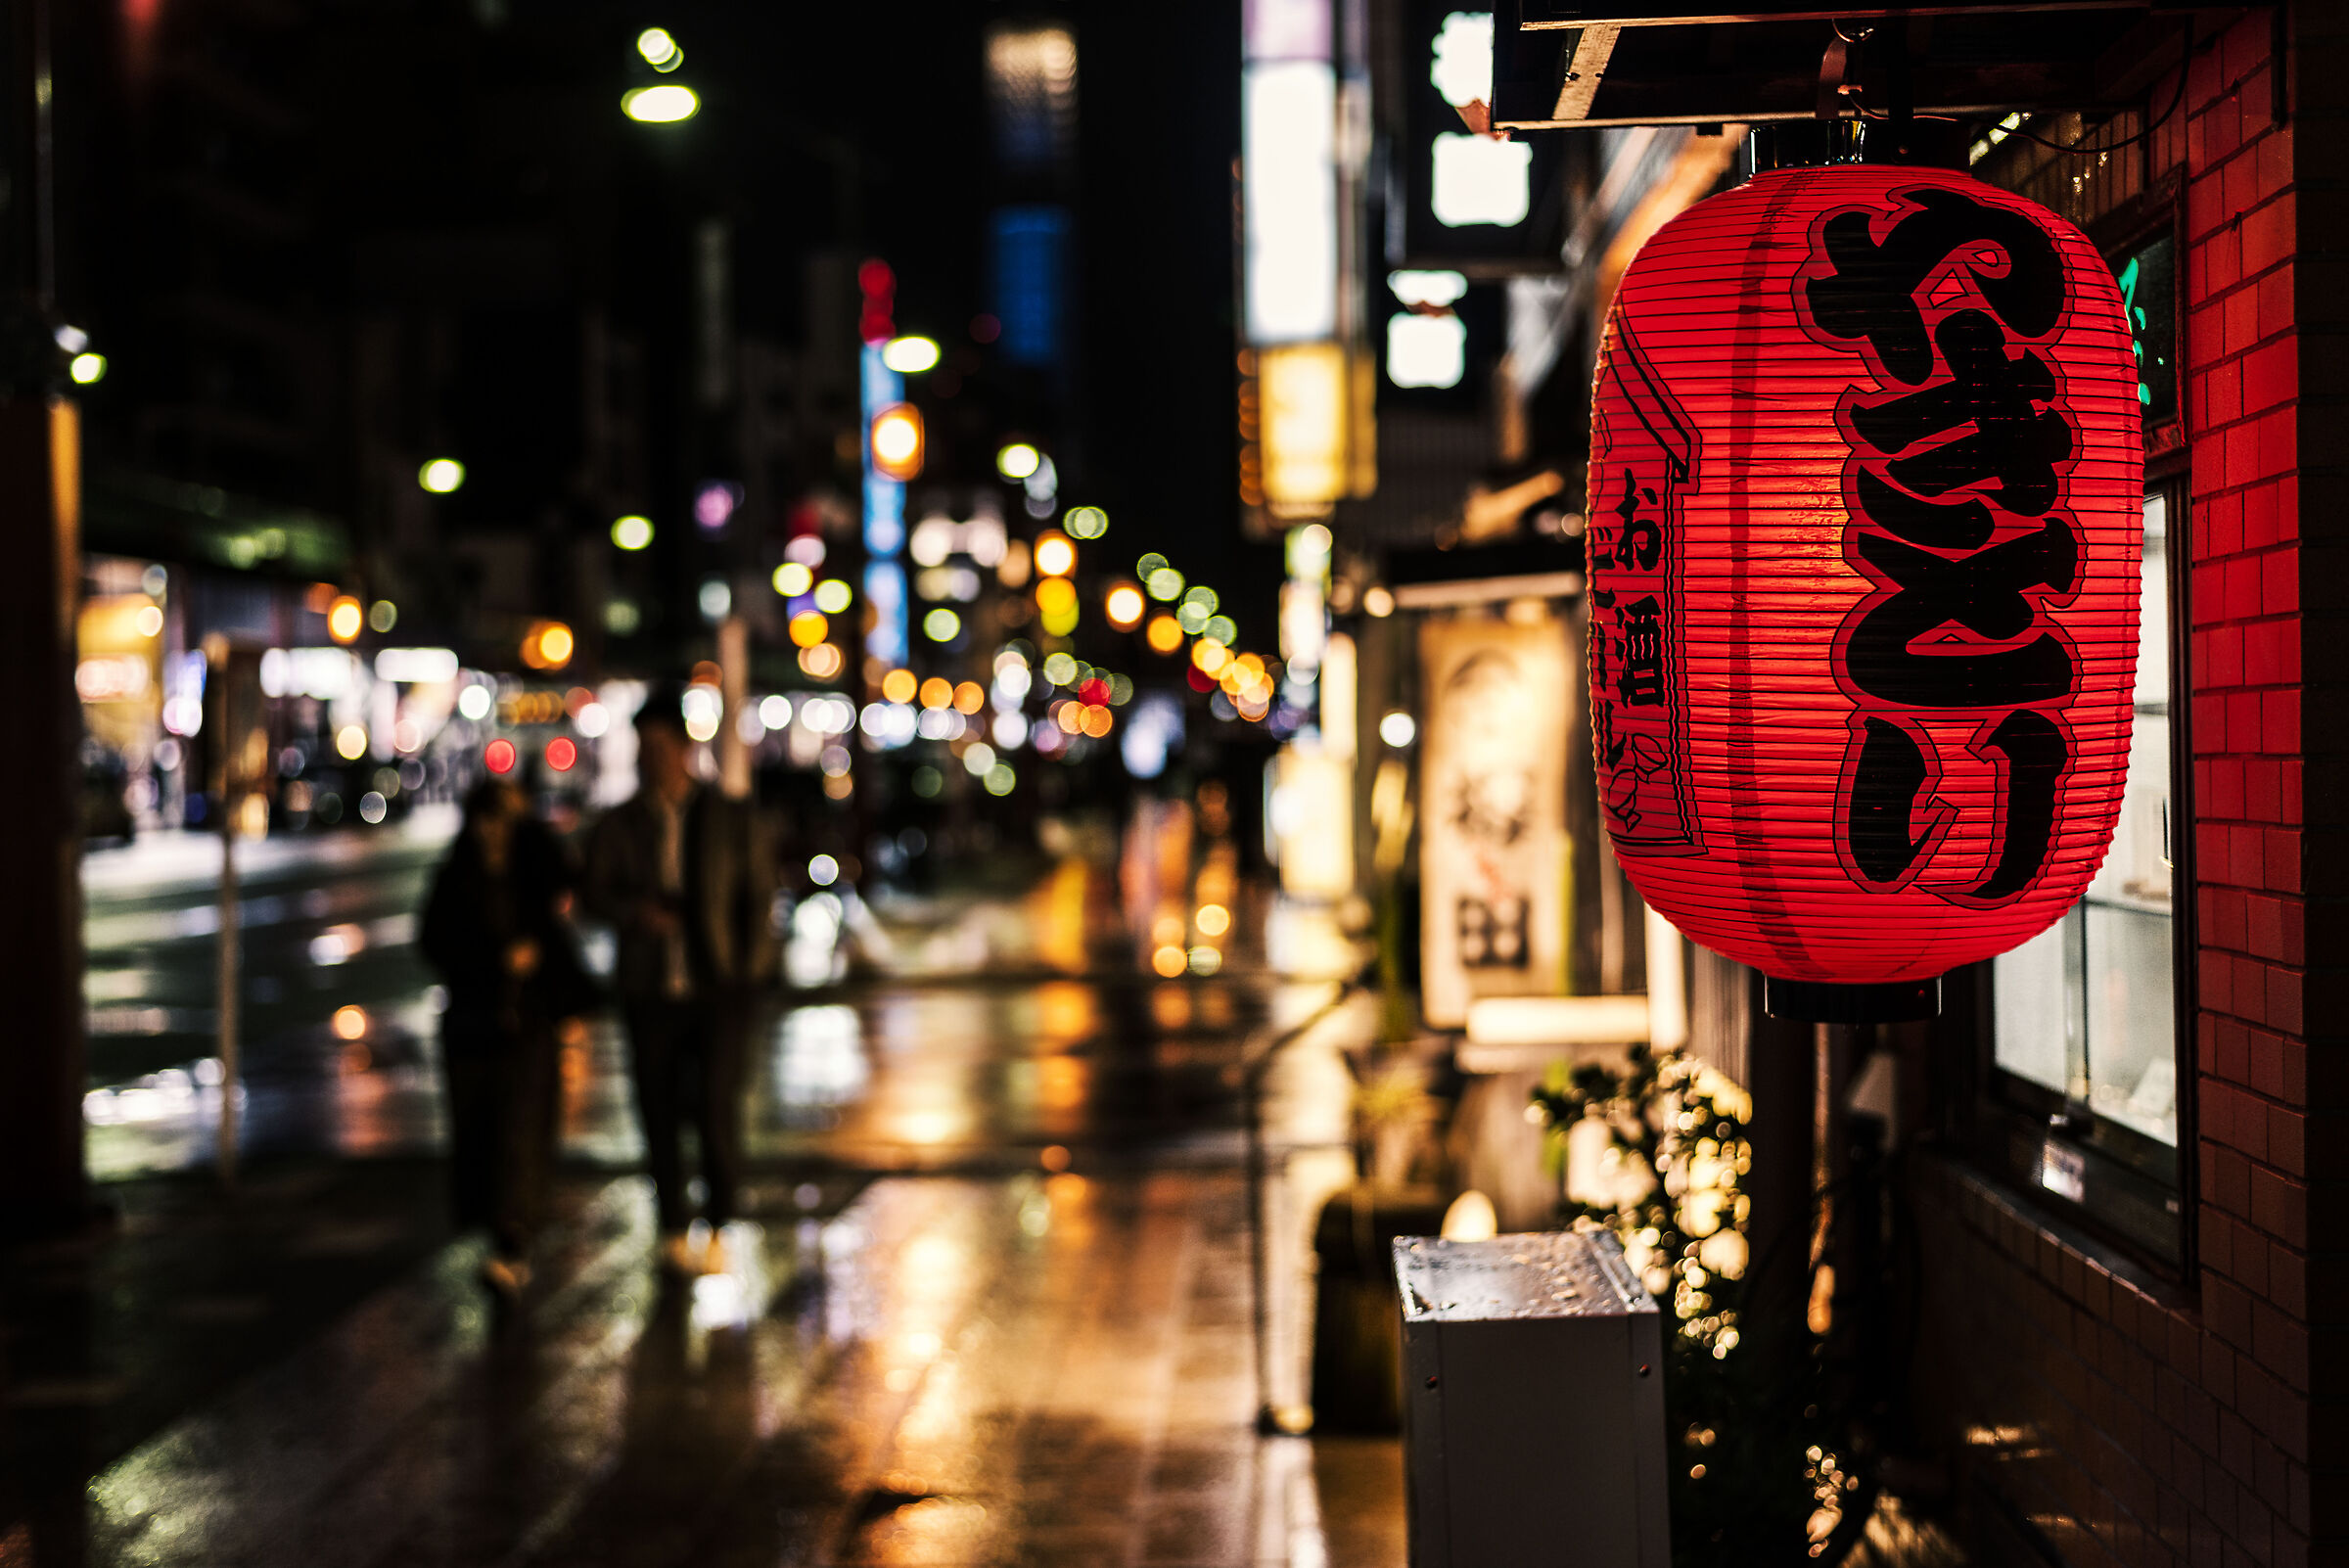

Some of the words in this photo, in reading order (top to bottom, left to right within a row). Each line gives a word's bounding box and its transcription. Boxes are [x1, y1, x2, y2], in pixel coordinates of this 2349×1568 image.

[1615, 468, 1665, 708] お酒
[1807, 188, 2075, 899] やきとり
